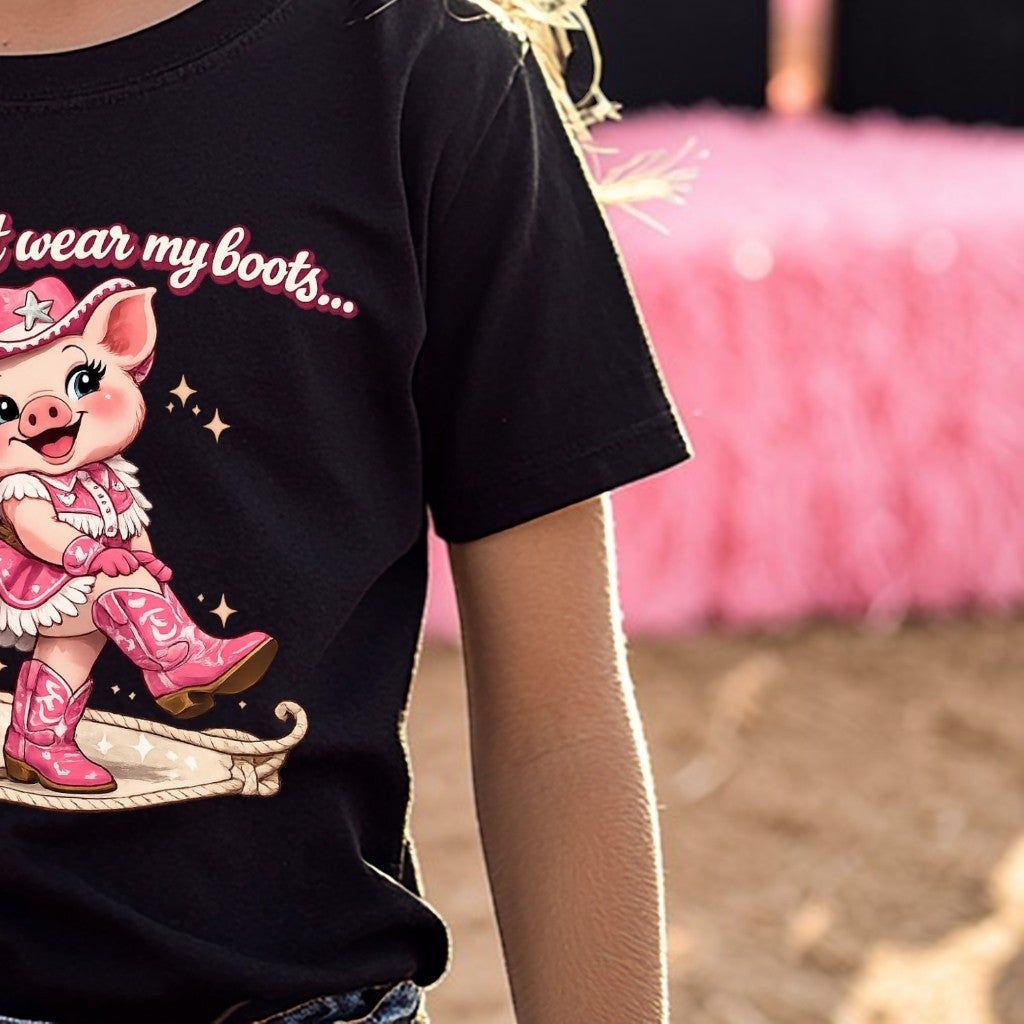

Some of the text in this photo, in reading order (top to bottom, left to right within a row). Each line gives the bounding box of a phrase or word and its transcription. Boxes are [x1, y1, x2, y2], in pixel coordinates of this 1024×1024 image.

[13, 223, 136, 268] wear
[140, 236, 211, 289] my
[210, 225, 357, 316] boots...
